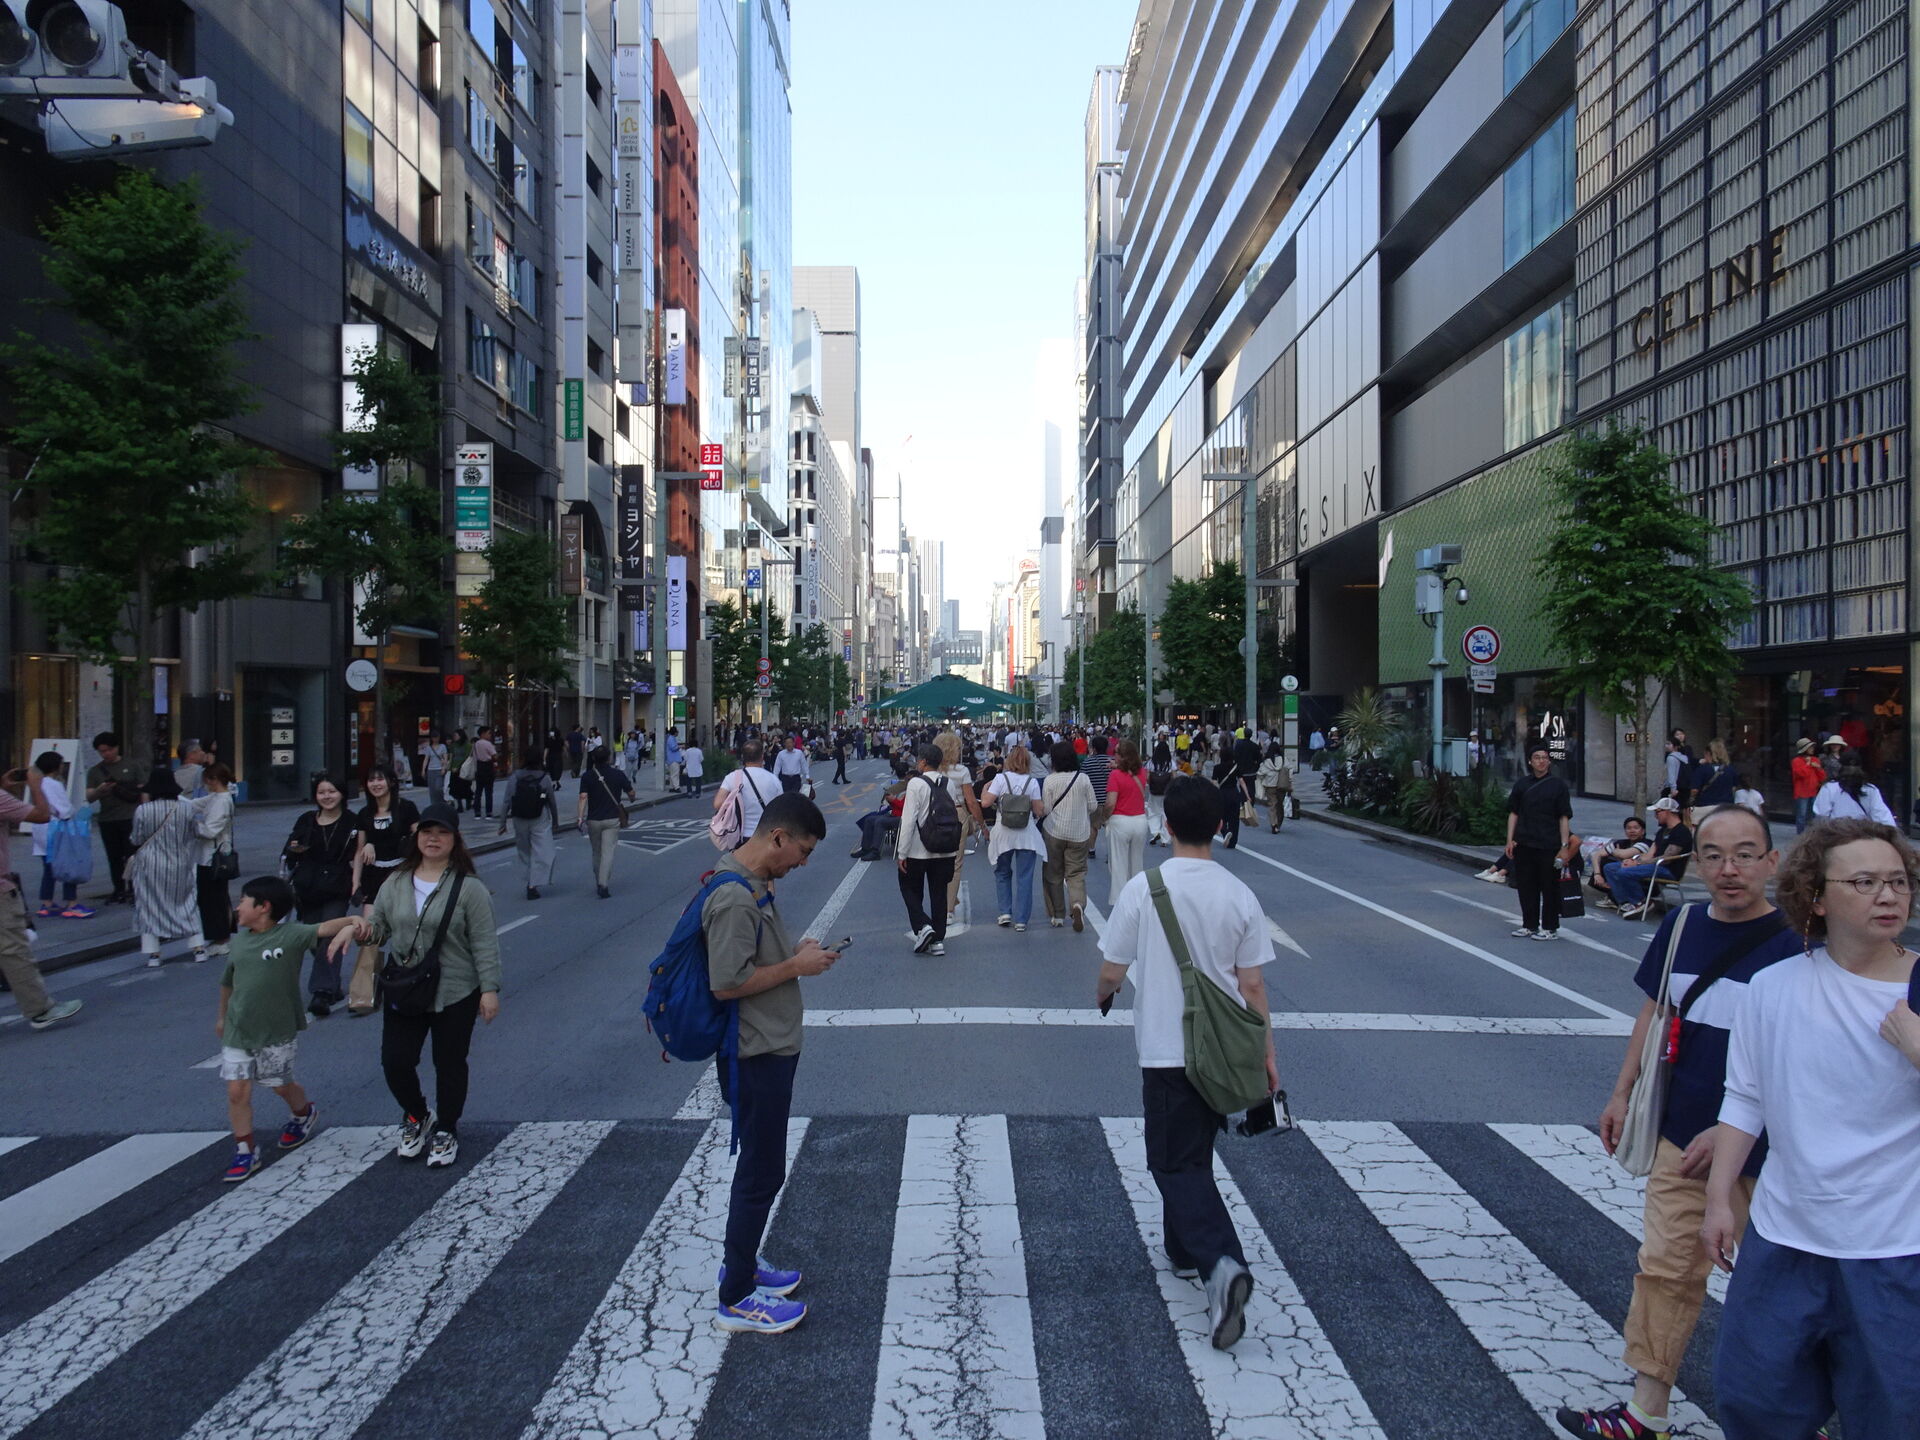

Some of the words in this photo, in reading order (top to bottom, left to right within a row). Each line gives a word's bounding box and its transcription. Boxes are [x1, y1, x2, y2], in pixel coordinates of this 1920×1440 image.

[1631, 225, 1786, 353] CELINE
[668, 339, 681, 381] DIANA
[703, 480, 720, 488] QLO
[565, 533, 578, 569] マギー
[626, 508, 640, 569] ヨシノヤ
[668, 586, 682, 627] DIANA
